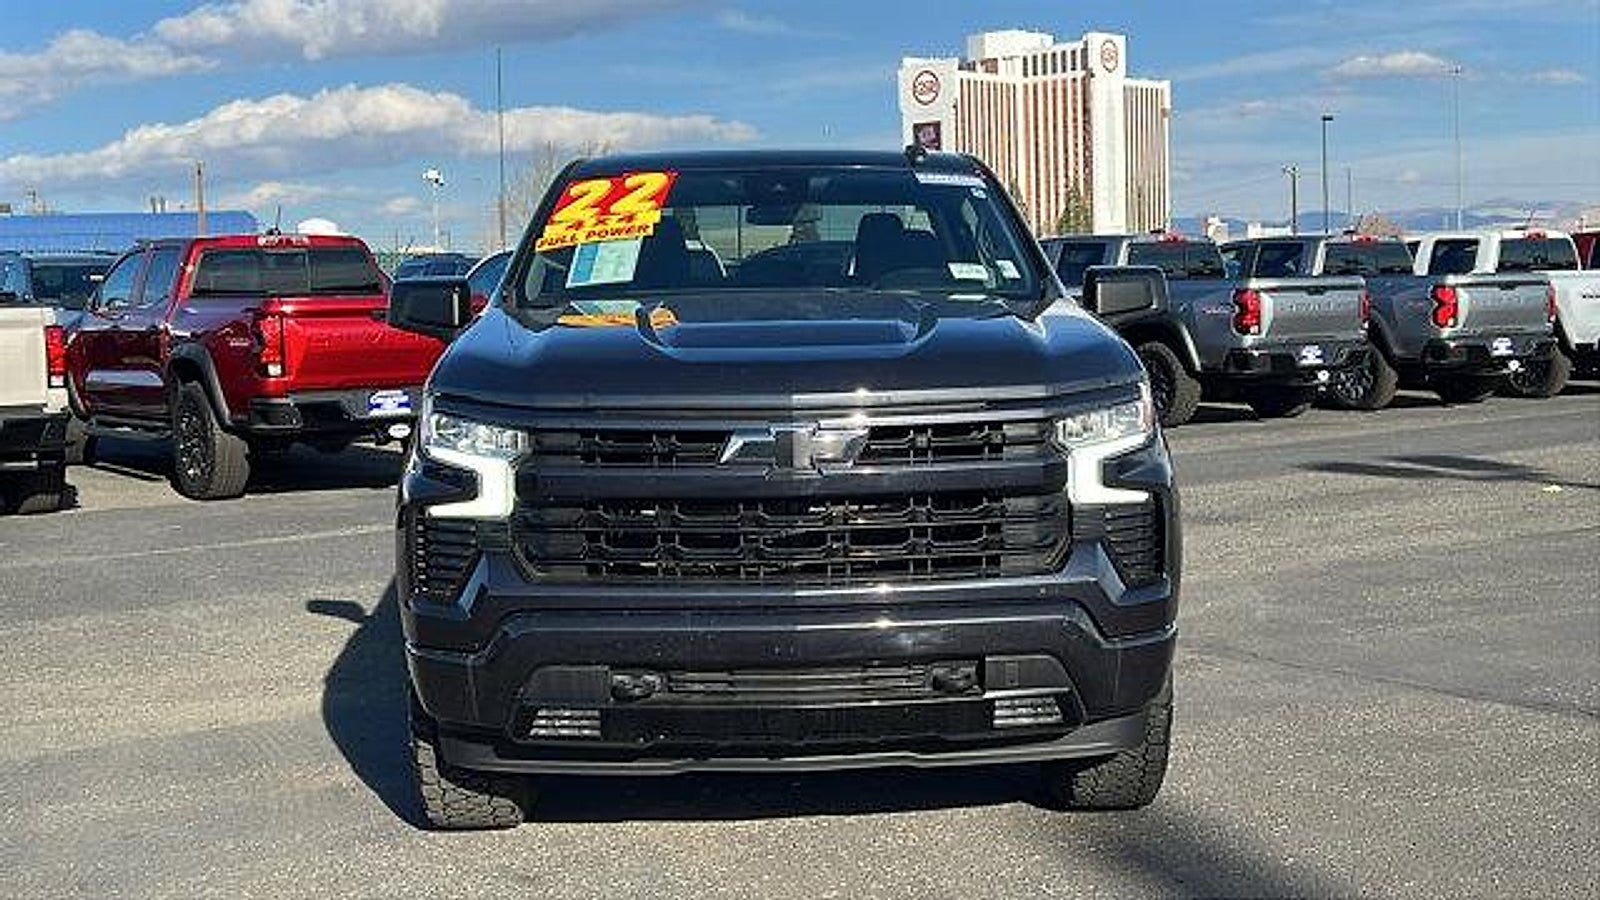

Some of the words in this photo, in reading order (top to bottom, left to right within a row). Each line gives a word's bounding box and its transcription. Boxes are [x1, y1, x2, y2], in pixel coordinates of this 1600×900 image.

[552, 172, 668, 223] 22
[537, 233, 578, 248] FULL
[585, 225, 649, 239] POWER
